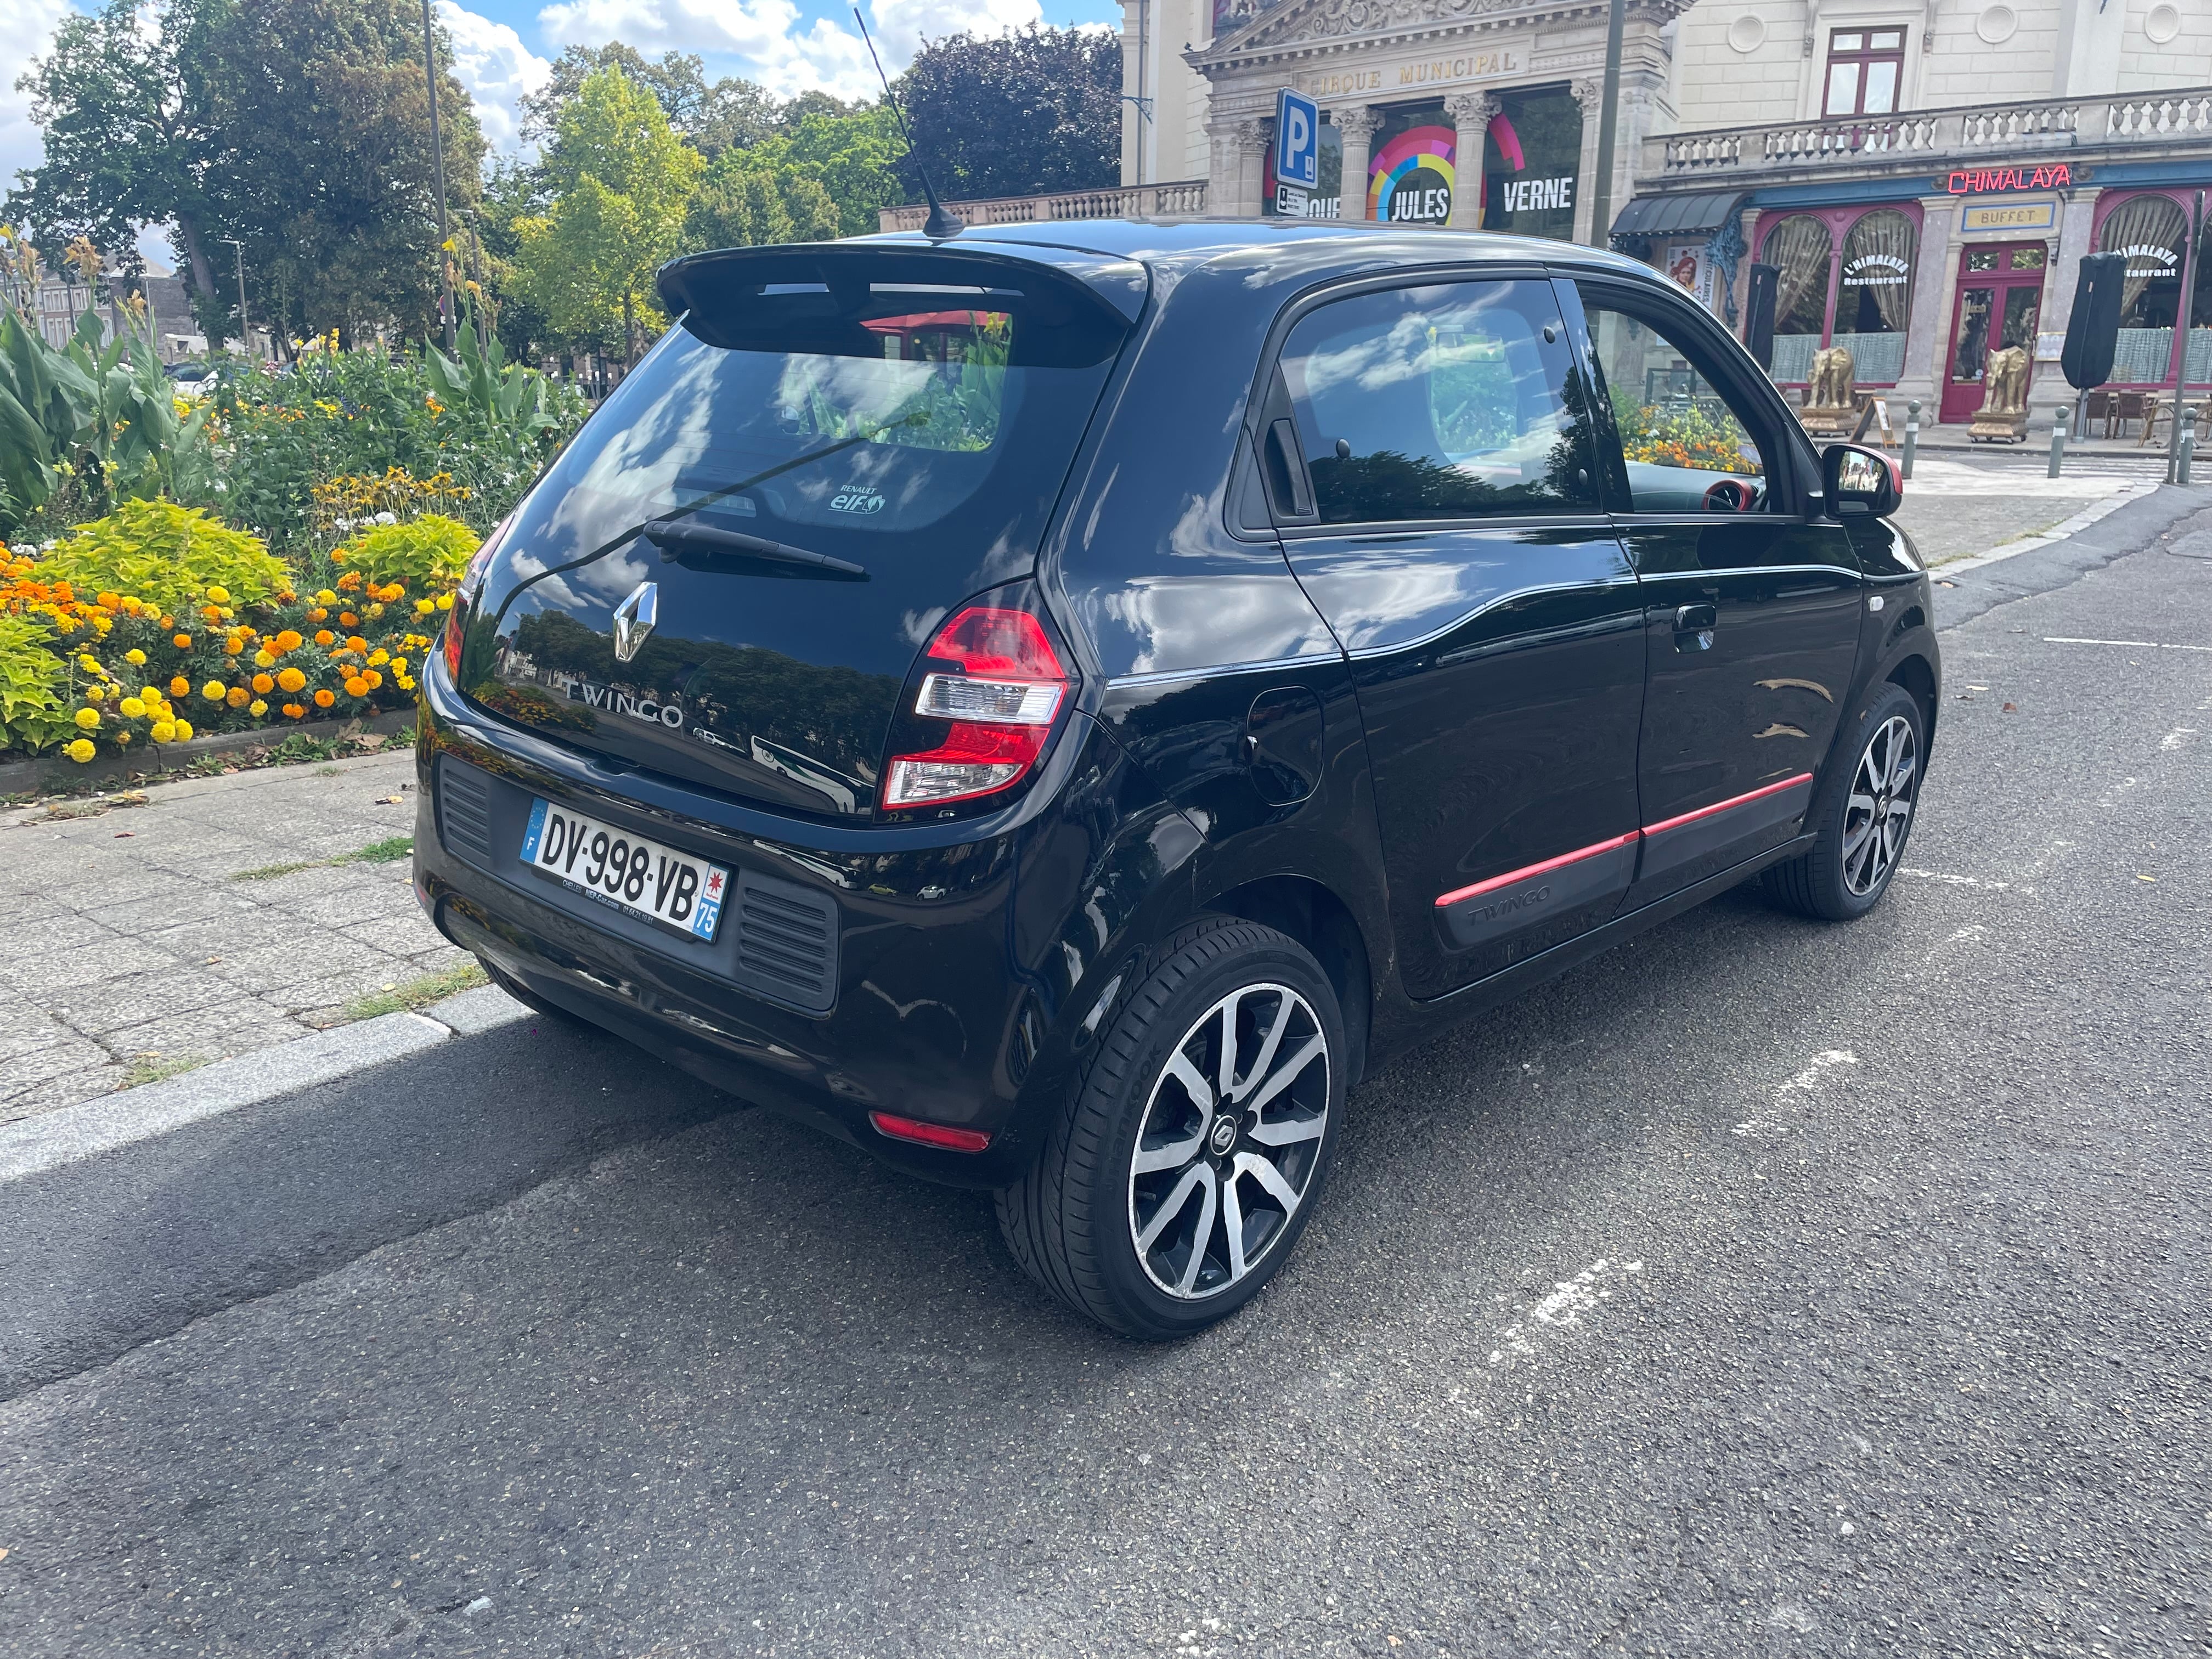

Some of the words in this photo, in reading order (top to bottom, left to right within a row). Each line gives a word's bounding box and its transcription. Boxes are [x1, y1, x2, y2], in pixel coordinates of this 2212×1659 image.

[1310, 70, 1381, 95] CIRQUE
[1400, 52, 1516, 84] MUNICIPAL
[1286, 106, 1310, 169] P
[1391, 188, 1448, 222] JULES
[1504, 177, 1573, 212] VERNE
[1980, 210, 2036, 224] BUFFET
[1843, 275, 1908, 286] Restaurant
[2124, 267, 2176, 278] taurant
[830, 495, 868, 510] elf
[840, 484, 877, 494] RENAULT
[561, 678, 684, 728] TWINGO
[526, 836, 535, 850] F
[541, 814, 698, 922] DV-998-VB
[562, 879, 583, 894] CHELLES
[585, 888, 619, 910] NEP-Car.com
[1468, 885, 1551, 927] TWINGO
[696, 902, 718, 933] 75
